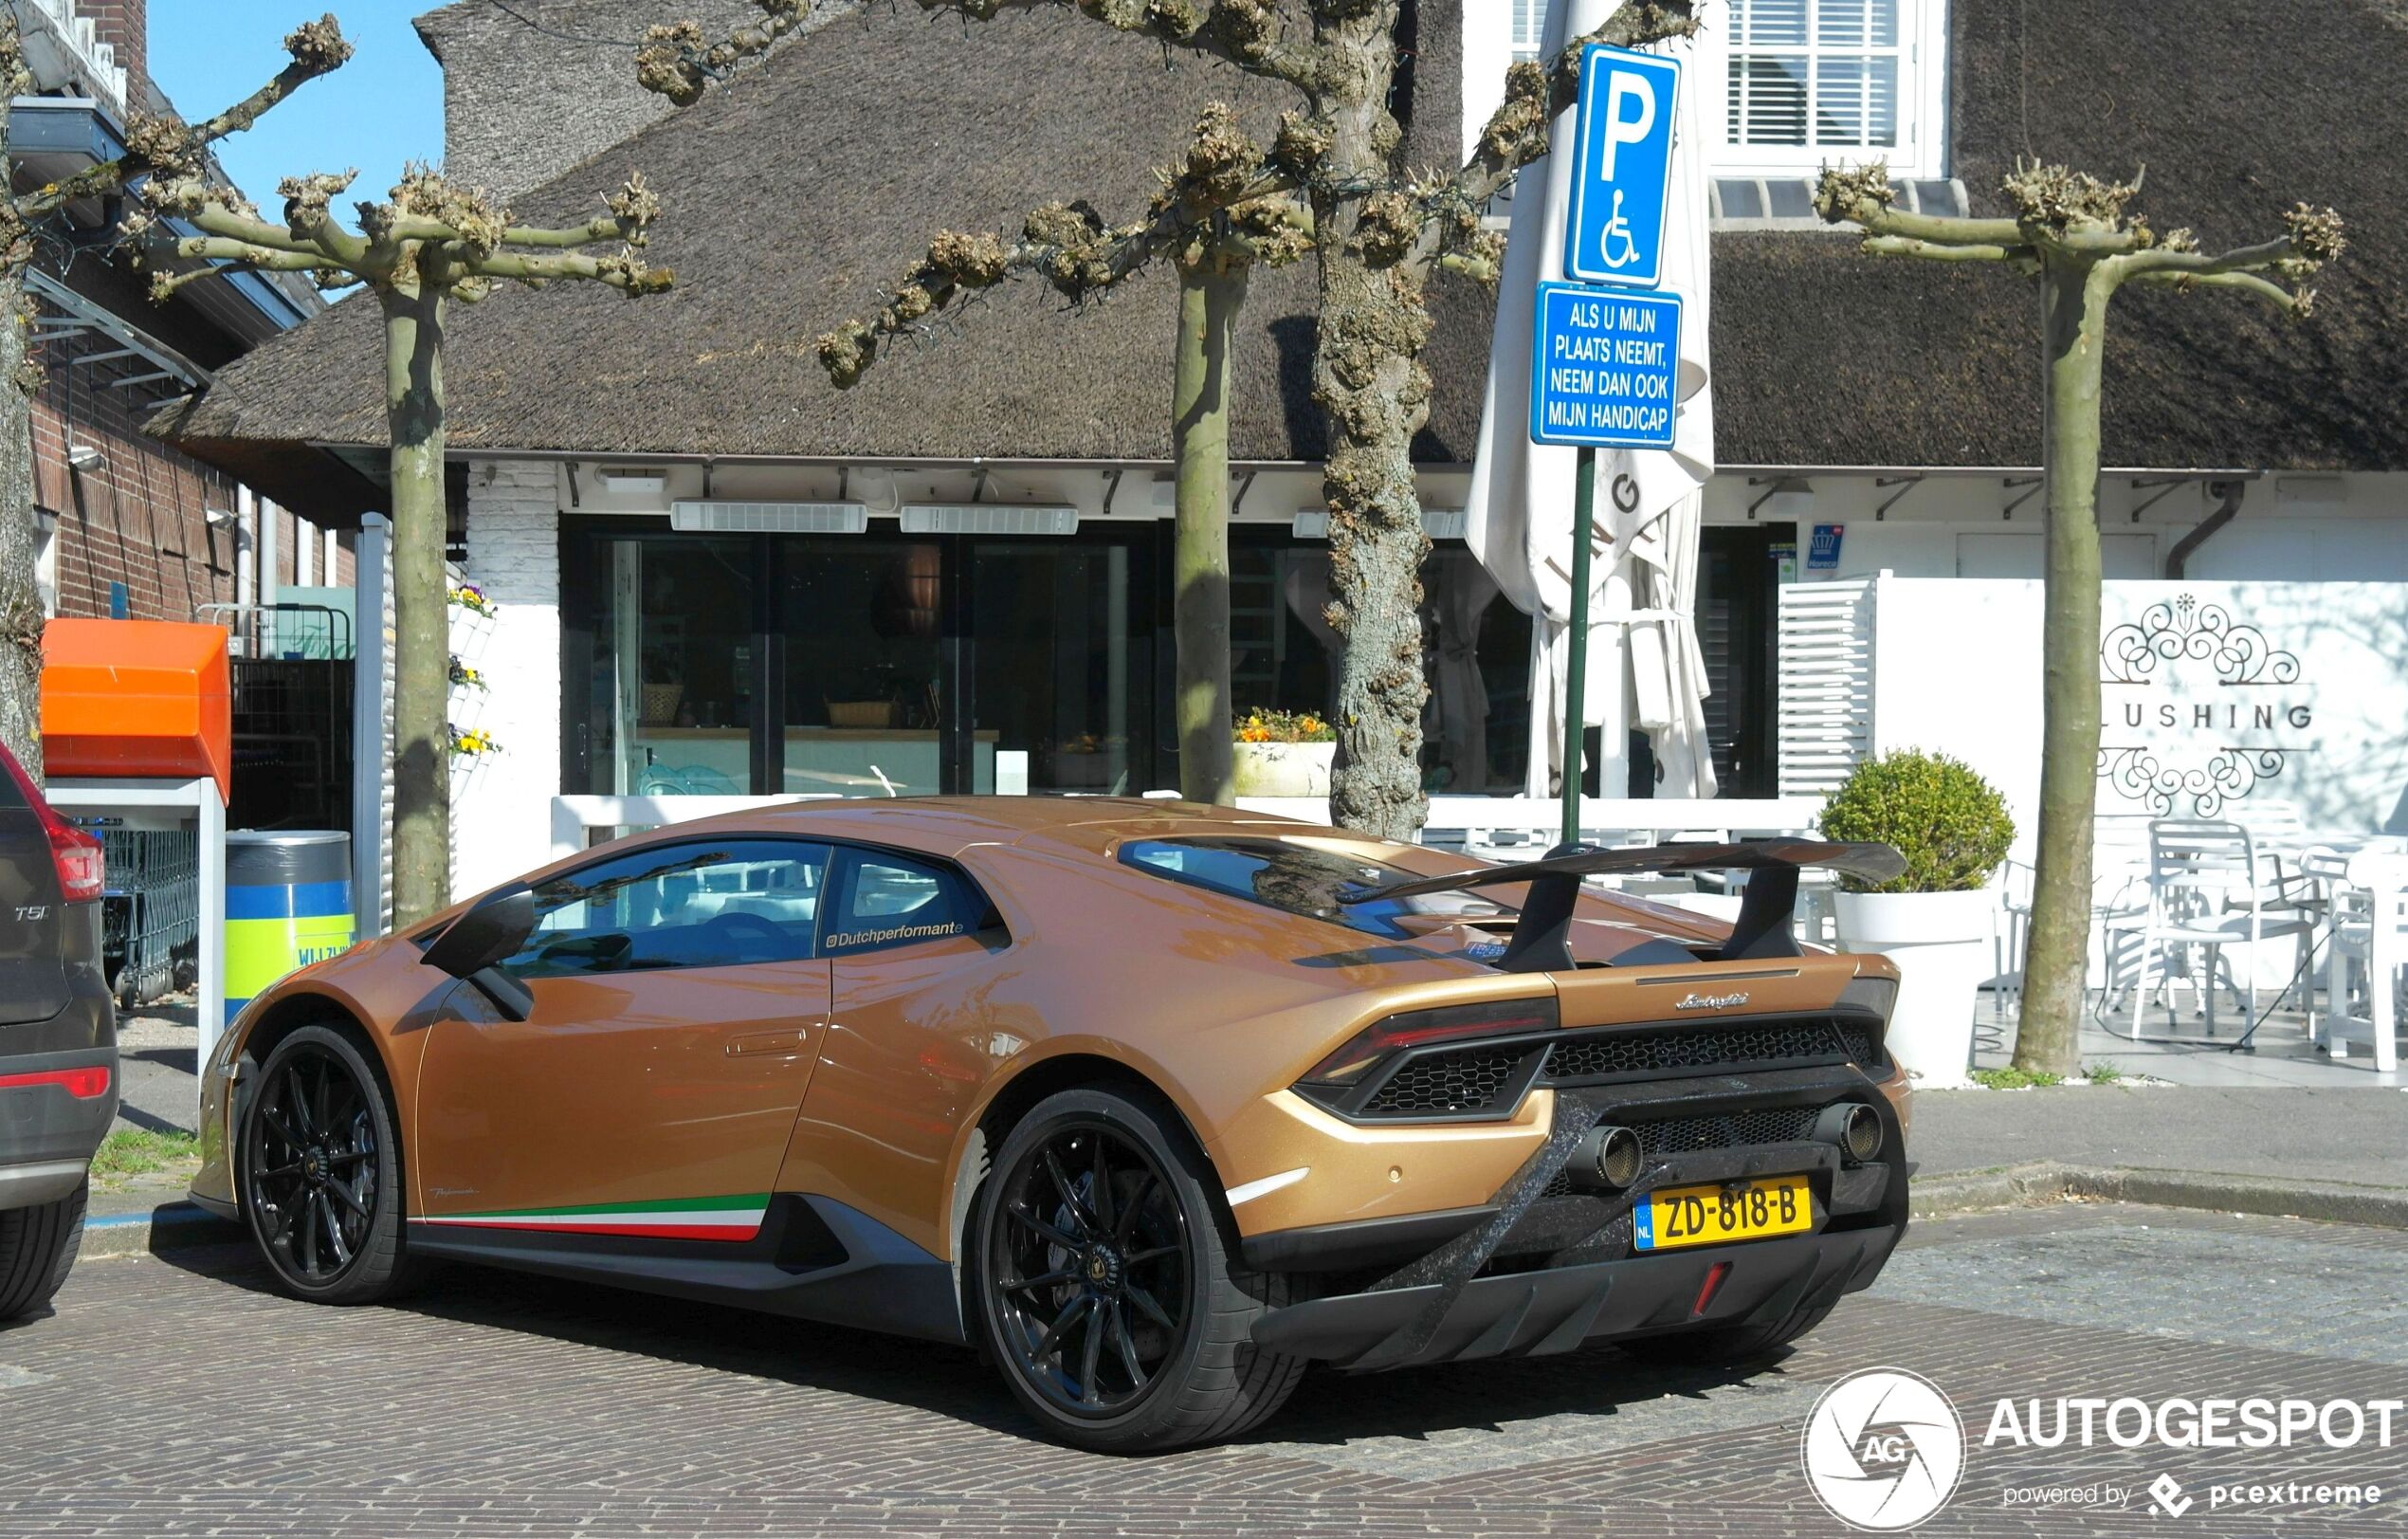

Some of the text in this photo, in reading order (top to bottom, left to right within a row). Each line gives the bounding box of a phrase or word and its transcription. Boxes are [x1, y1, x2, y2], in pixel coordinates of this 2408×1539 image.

[1600, 69, 1656, 182] P
[1569, 302, 1656, 333] ALS U MIJN
[1555, 334, 1667, 370] PLAATS NEEMT,
[1550, 367, 1669, 400] NEEM DAN OOK
[1548, 400, 1668, 432] MIJN HANDICAP
[2101, 704, 2312, 729] USHING
[838, 921, 964, 947] Dutchperformante
[1637, 1184, 1797, 1238] NL ZD-818-B
